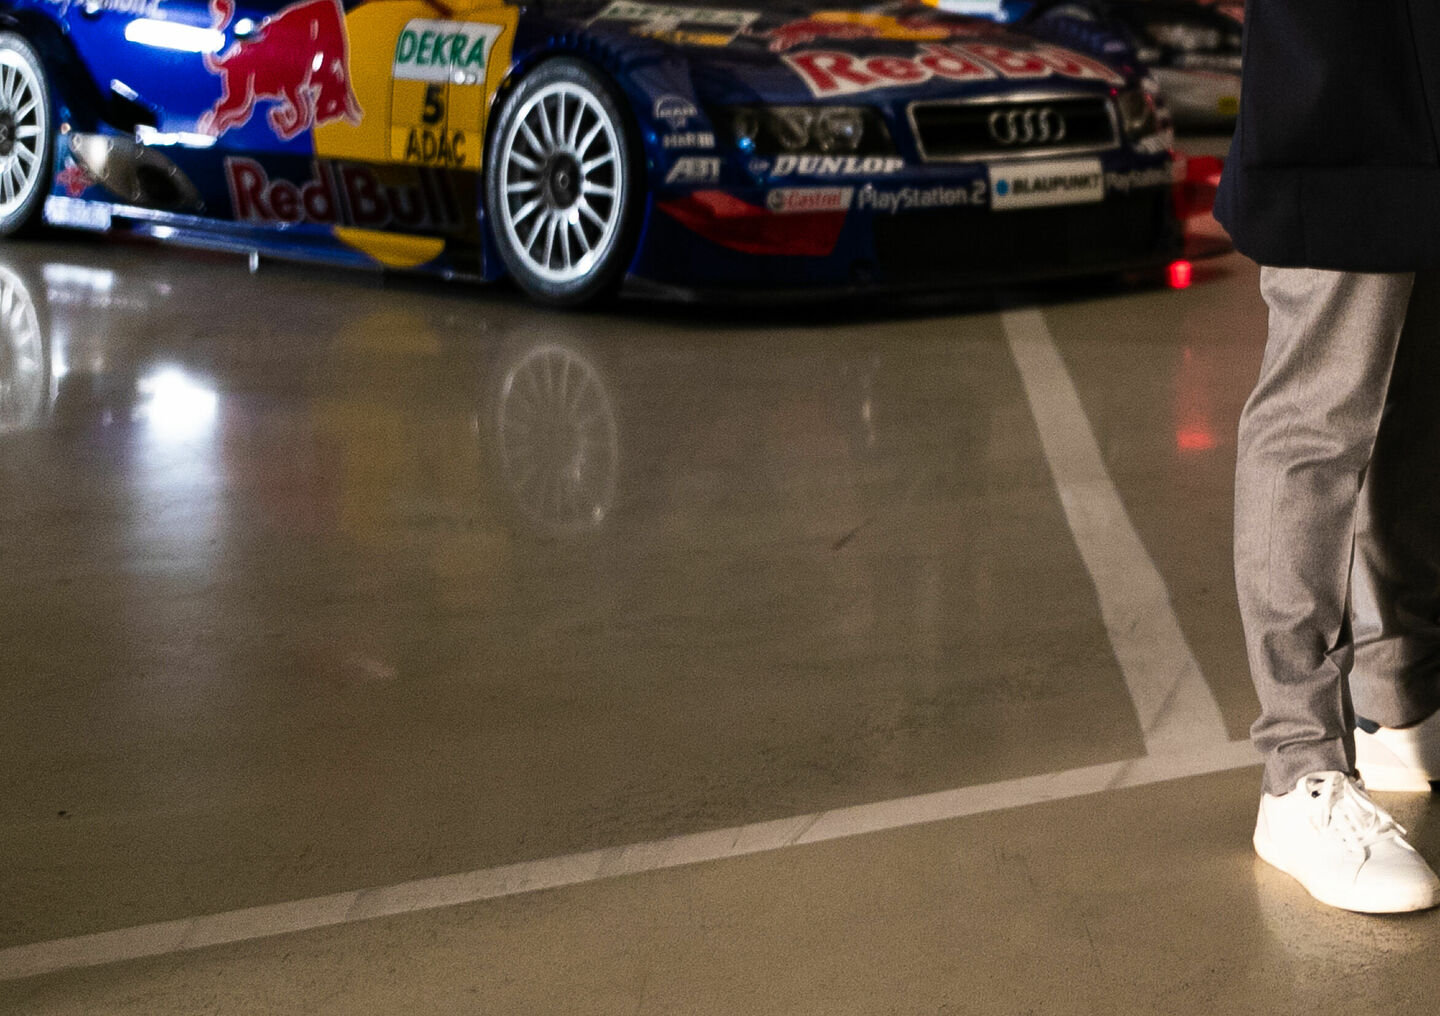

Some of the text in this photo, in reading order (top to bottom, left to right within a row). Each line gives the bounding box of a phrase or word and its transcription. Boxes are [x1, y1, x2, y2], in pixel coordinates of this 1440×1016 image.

[397, 29, 487, 68] DEKRA
[785, 42, 998, 98] Red
[423, 83, 444, 124] 5
[406, 127, 467, 163] ADAC
[770, 154, 905, 177] DUNLOP
[223, 155, 464, 230] Red Bull
[857, 182, 967, 214] PlayStation
